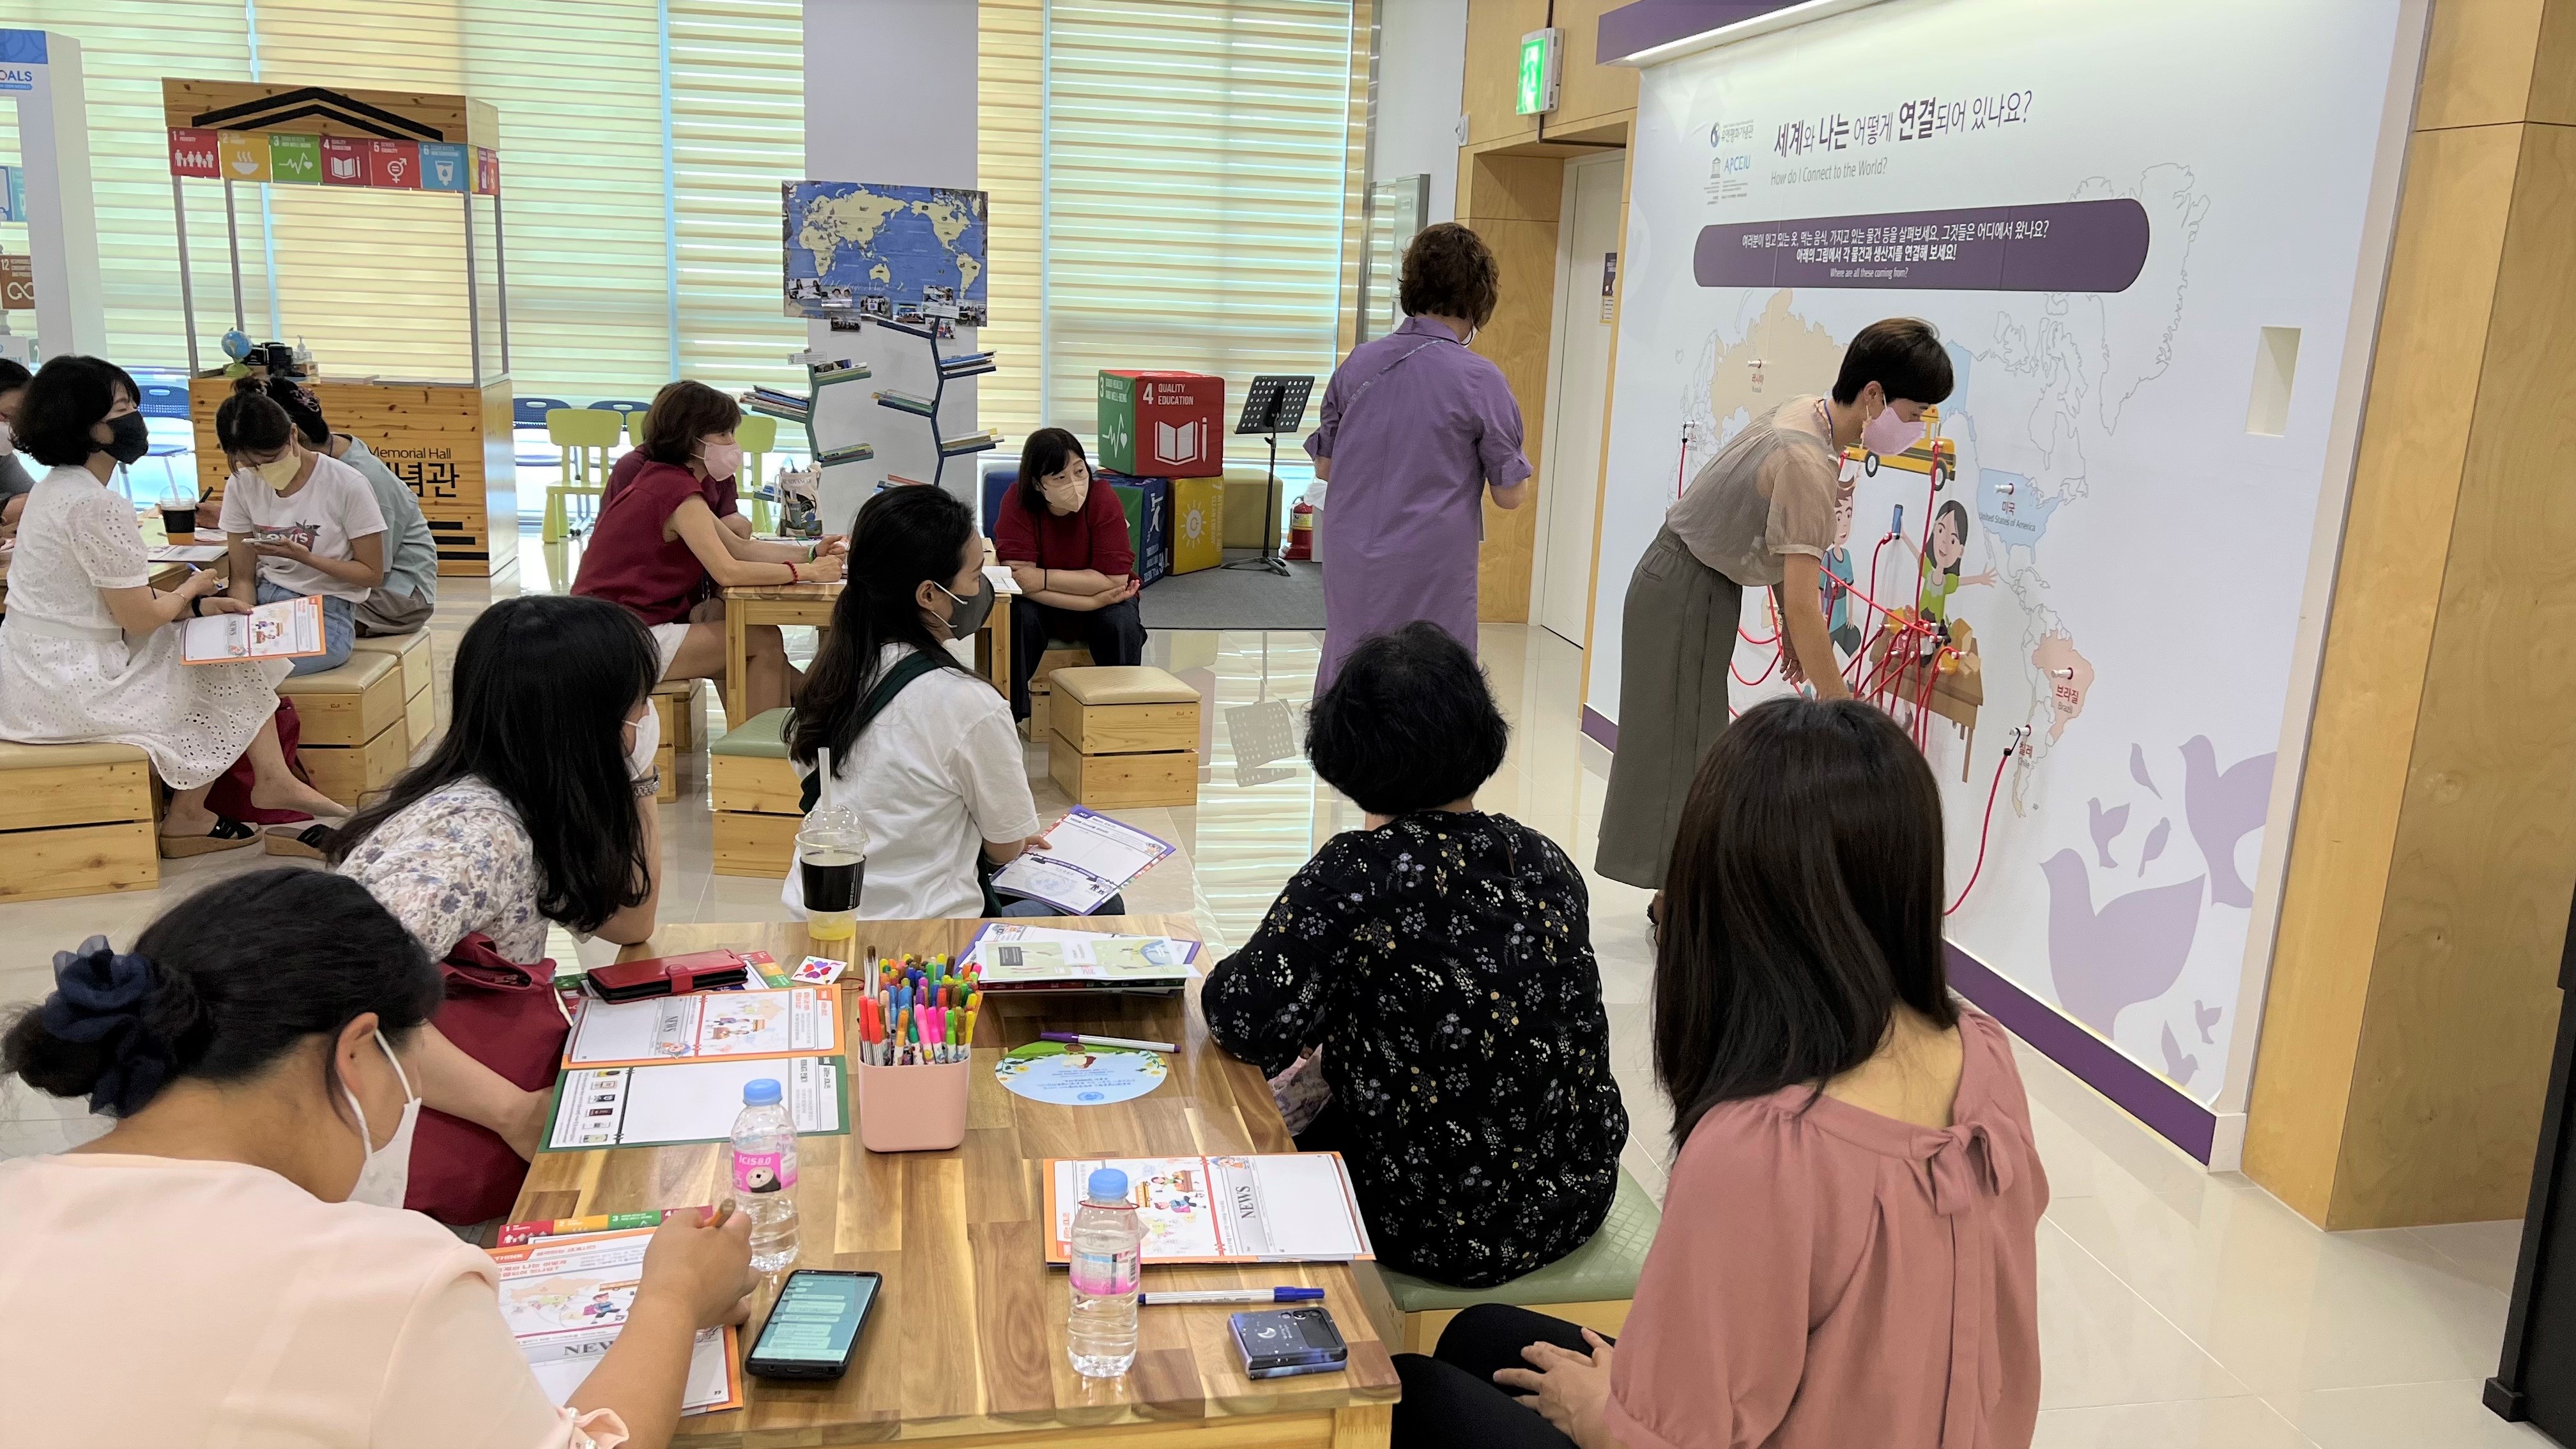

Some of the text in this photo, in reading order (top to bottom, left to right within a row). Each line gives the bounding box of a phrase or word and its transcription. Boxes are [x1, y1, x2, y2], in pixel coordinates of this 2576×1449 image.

[0, 70, 33, 82] OALS
[1774, 89, 2032, 158] 세계와 나는 어떻게 연결되어 있나요?
[172, 130, 176, 141] 1
[273, 136, 280, 146] 3
[323, 139, 330, 150] 4
[373, 142, 379, 152] 5
[1724, 155, 1751, 174] APCEIU
[1770, 157, 1888, 186] How do I Connect to the World?
[1742, 234, 1765, 249] 여러분이
[1765, 233, 1777, 248] 입고
[1777, 232, 1790, 247] 있는
[1800, 231, 1813, 246] 먹는
[1813, 230, 1828, 246] 음식,
[1829, 229, 1849, 245] 가지고
[1851, 228, 1865, 244] 있는
[1866, 227, 1882, 244] 물건
[1883, 226, 1898, 243] 등을
[1941, 223, 1975, 241] 그것들은
[1977, 221, 2013, 240] 어디에서
[2014, 220, 2050, 240] 왔나요?
[1797, 243, 1958, 264] 아래의 그림에서 각 물건과 생산지를 연결해 보세요!
[1, 258, 10, 270] 12
[1830, 268, 1844, 278] Where
[1860, 267, 1874, 278] these
[1874, 267, 1892, 280] coming
[1892, 266, 1908, 278] from?
[1100, 376, 1104, 398] 3
[1143, 383, 1186, 404] 4 QUALITY
[1158, 395, 1193, 406] EDUCATION
[368, 446, 452, 459] Memorial Hall
[386, 461, 460, 498] 념관
[2002, 501, 2016, 516] 미국
[1979, 511, 2036, 532] United States of America
[2055, 684, 2079, 705] 브라질
[2058, 701, 2073, 714] Brazil
[2019, 741, 2033, 759] 칠레
[663, 1015, 678, 1032] NEWS
[1235, 1186, 1256, 1219] NEWS
[564, 1341, 613, 1356] NEW
